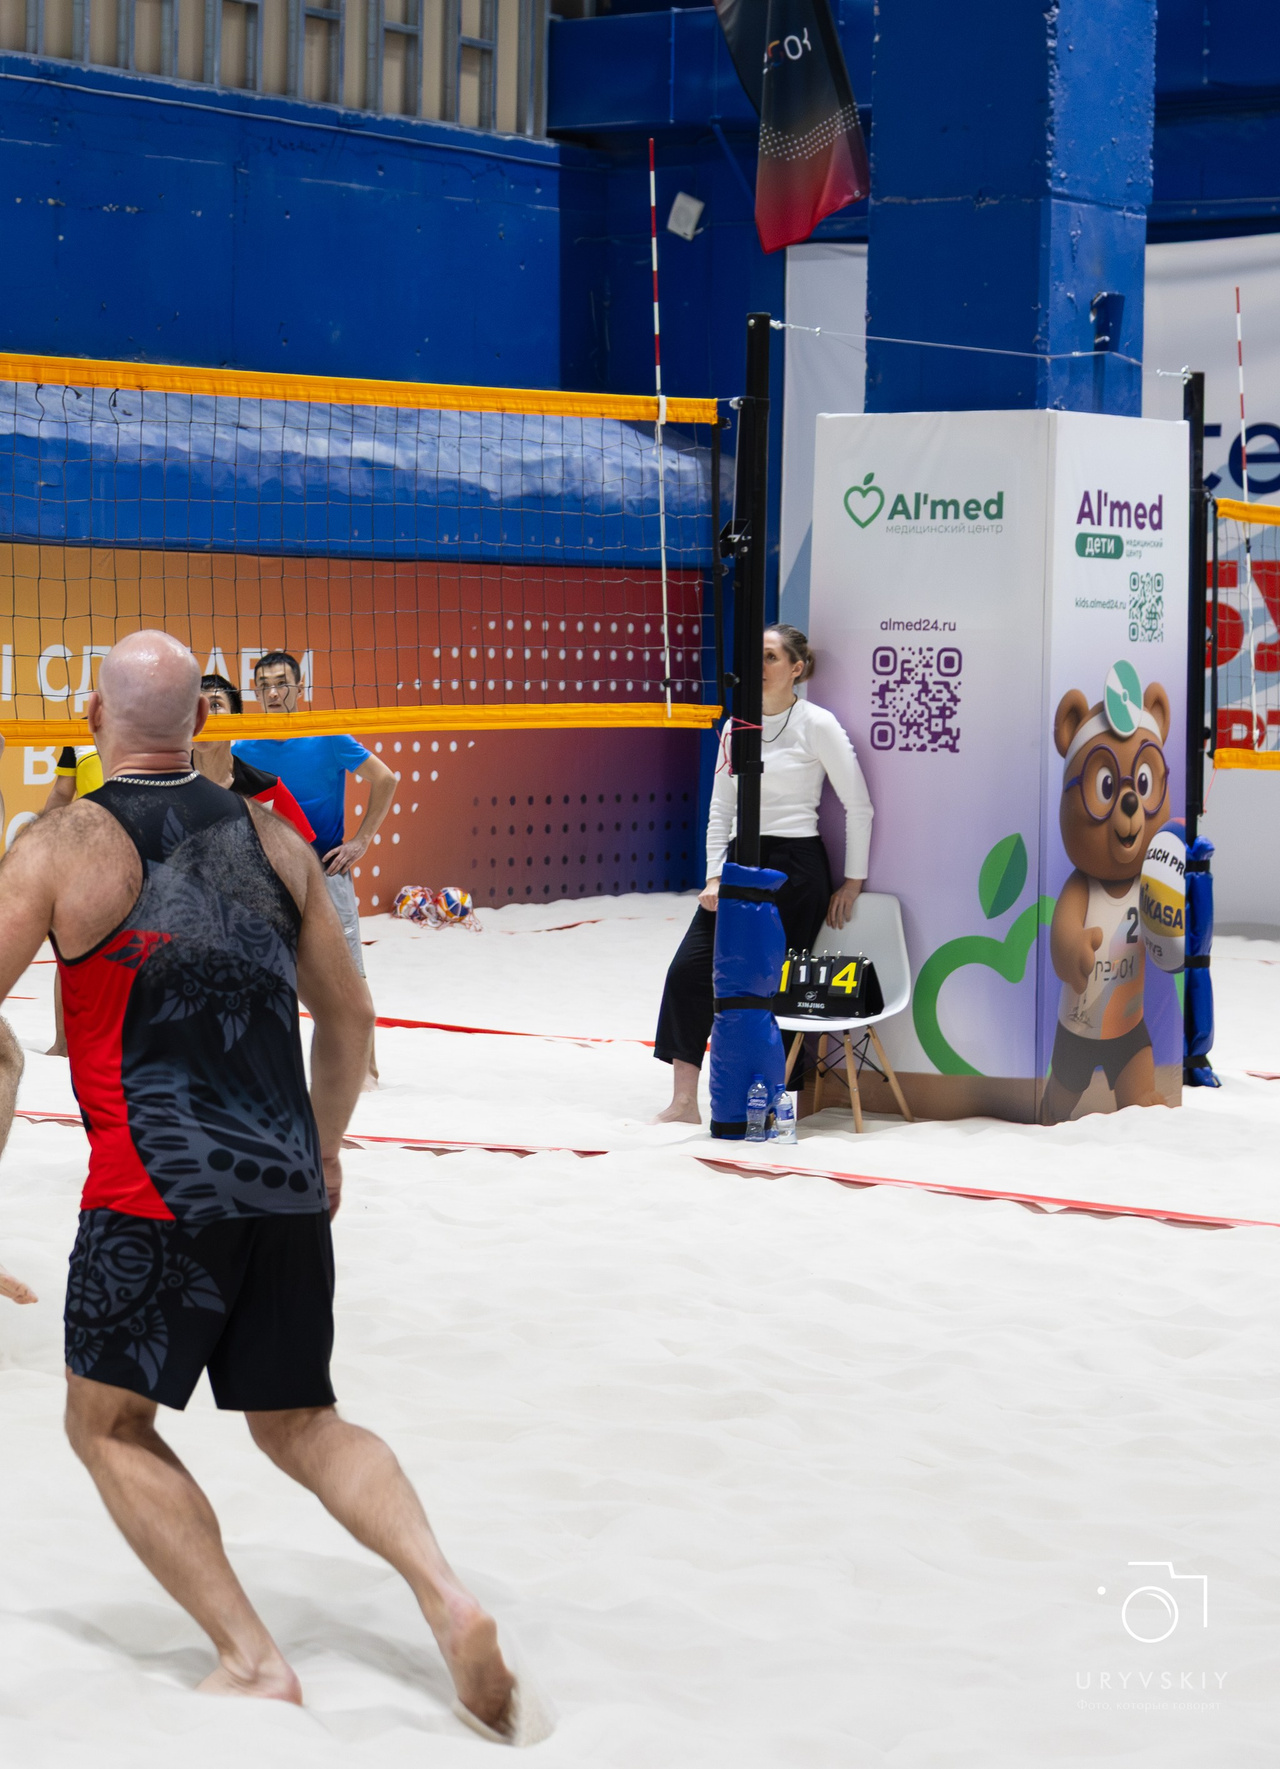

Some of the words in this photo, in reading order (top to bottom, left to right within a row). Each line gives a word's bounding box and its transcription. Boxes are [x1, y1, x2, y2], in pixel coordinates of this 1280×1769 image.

[887, 491, 1004, 520] Al'med
[1076, 489, 1163, 531] Al'med
[885, 523, 966, 535] медицинский
[968, 524, 1004, 535] центр
[880, 618, 957, 632] almed24.ru
[1126, 907, 1138, 944] 2
[799, 965, 807, 983] 1
[819, 966, 827, 984] 1
[831, 962, 858, 994] 4
